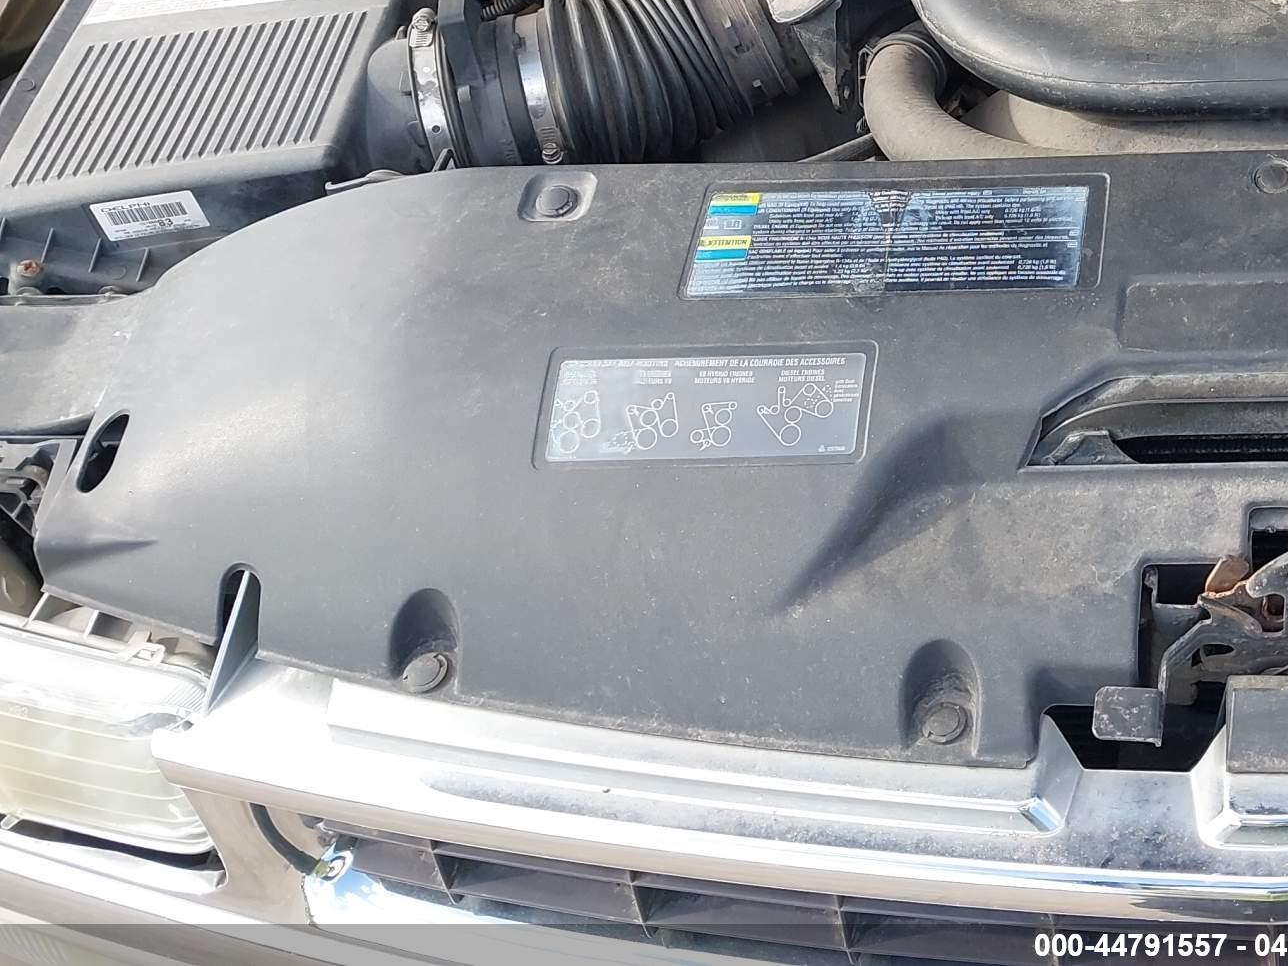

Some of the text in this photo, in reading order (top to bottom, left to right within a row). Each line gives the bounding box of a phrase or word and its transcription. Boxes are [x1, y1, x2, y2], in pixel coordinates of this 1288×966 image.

[100, 201, 151, 213] DELPHI
[740, 359, 749, 367] LA
[750, 357, 784, 367] COURROIE
[785, 357, 799, 366] DES
[800, 356, 847, 366] ACCESSOIRES
